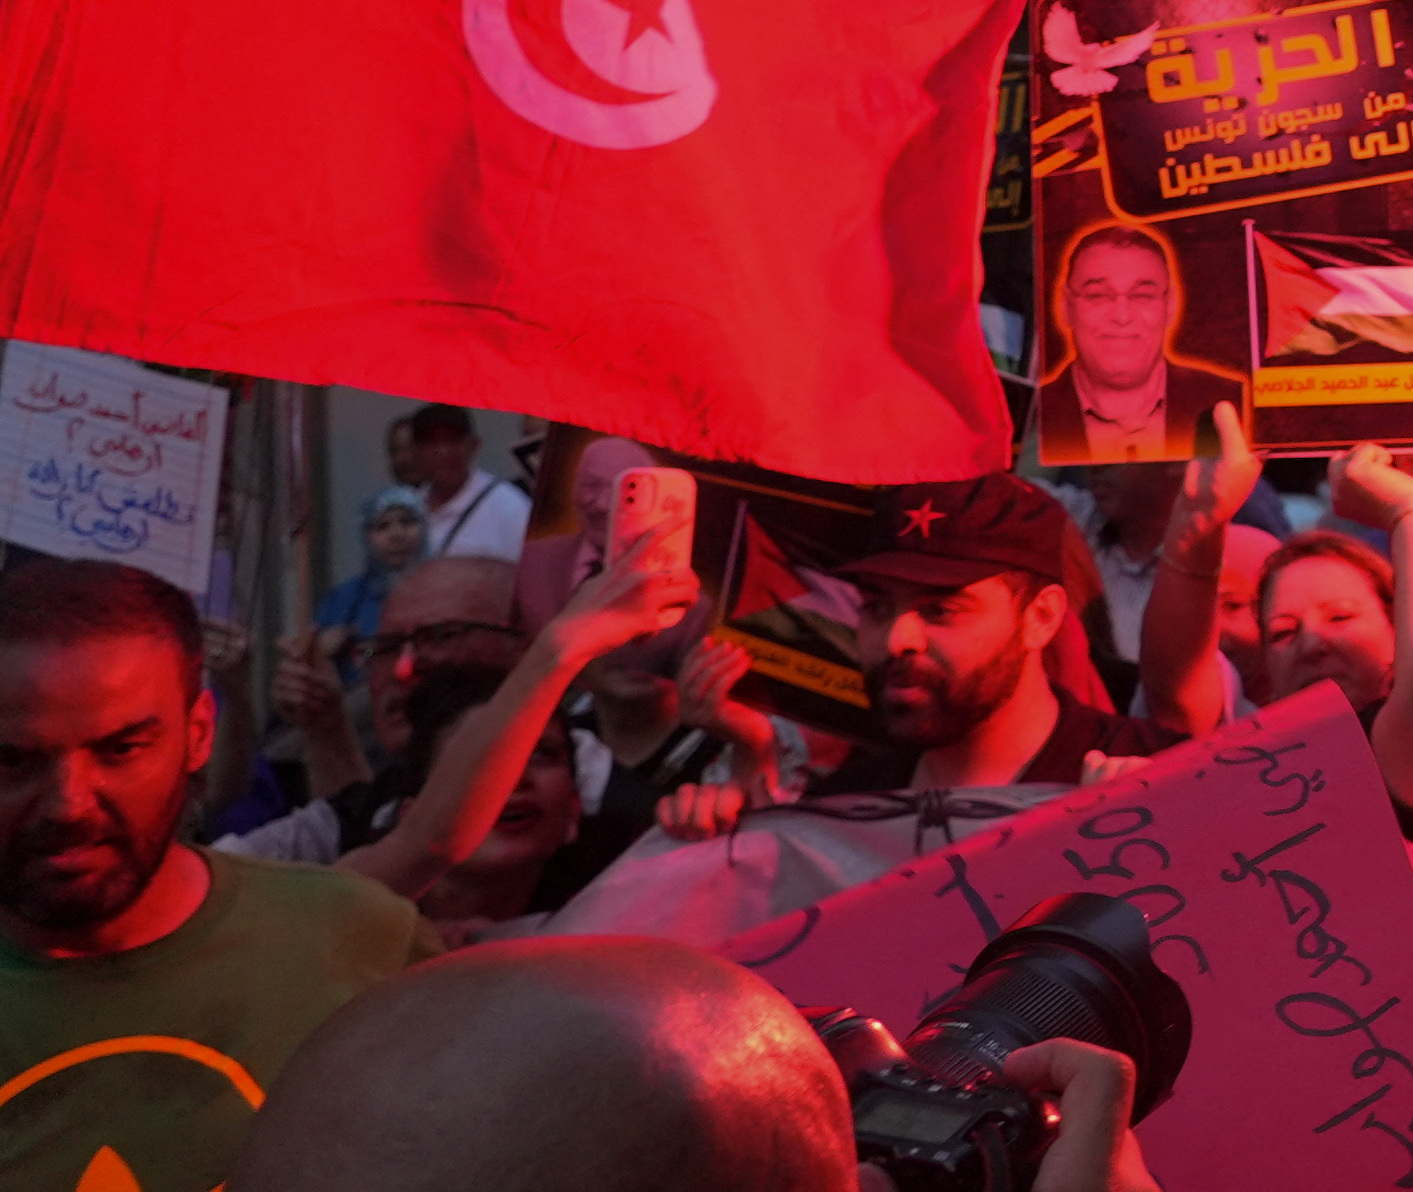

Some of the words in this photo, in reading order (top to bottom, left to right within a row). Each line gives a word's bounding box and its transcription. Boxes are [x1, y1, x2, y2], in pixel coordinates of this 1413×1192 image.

[1145, 8, 1396, 110] الحرية
[1257, 101, 1343, 138] سجون
[1363, 90, 1407, 120] من
[1163, 115, 1248, 154] تونس
[1158, 136, 1333, 200] فلسطين
